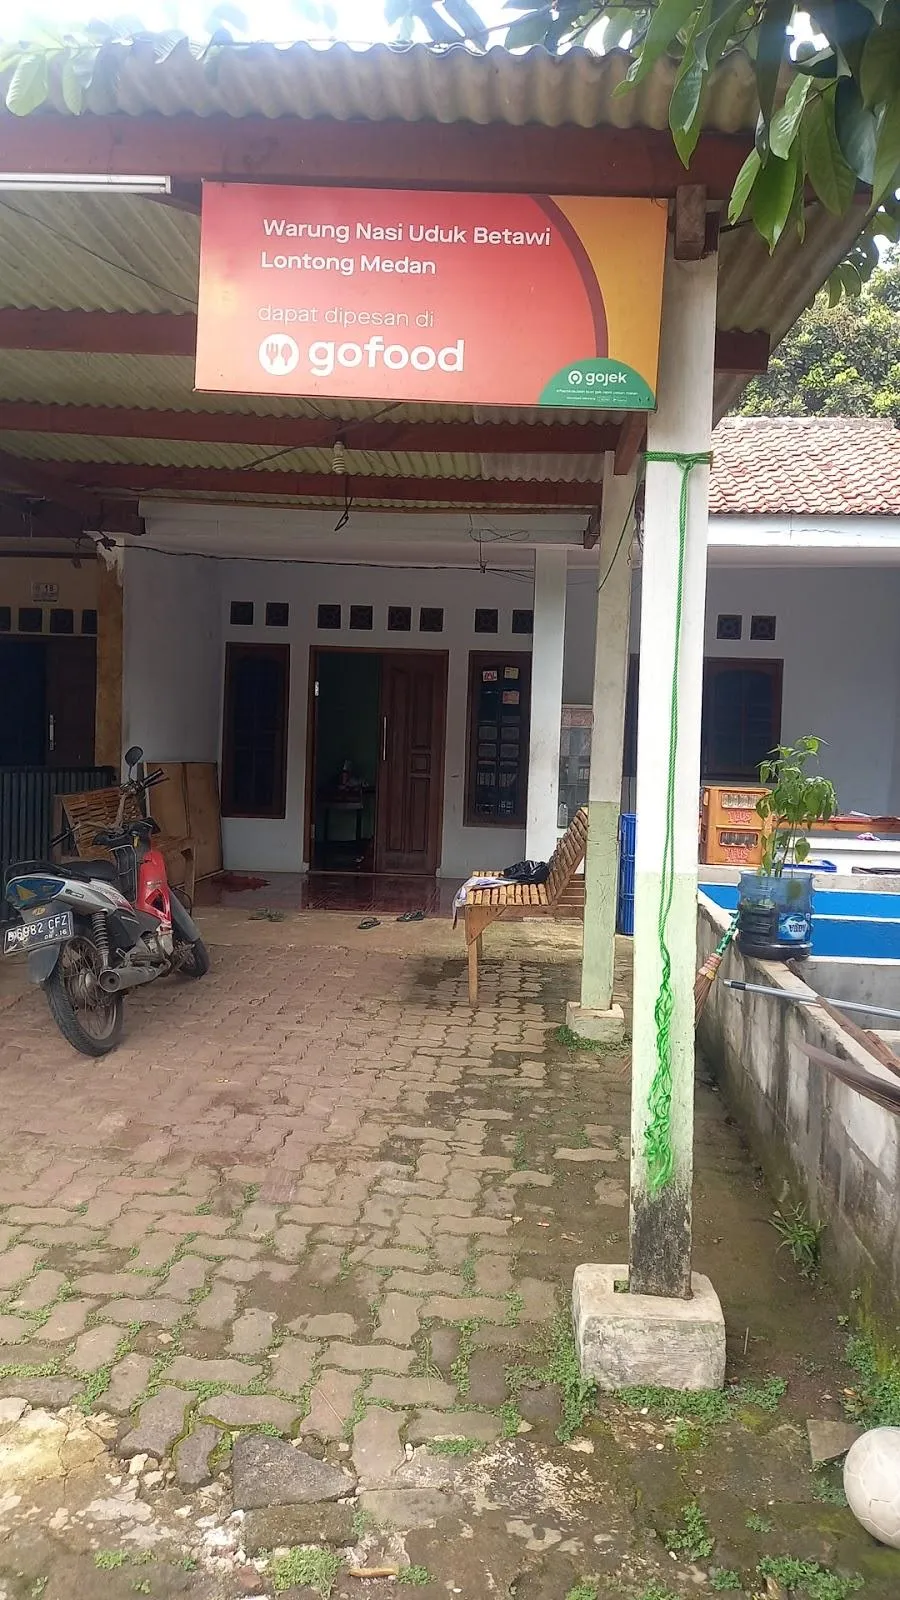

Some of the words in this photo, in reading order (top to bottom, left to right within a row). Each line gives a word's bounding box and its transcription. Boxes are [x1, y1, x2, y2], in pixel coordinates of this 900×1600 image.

[263, 218, 351, 244] Warung
[356, 222, 404, 241] Nasi
[409, 224, 468, 243] Uduk
[473, 227, 552, 246] Betawi
[261, 250, 354, 276] Lontong
[360, 253, 437, 275] Medan
[257, 304, 319, 325] dapat
[324, 307, 409, 329] dipesan
[415, 311, 435, 328] di
[307, 335, 465, 377] gofood
[585, 371, 628, 386] gojek
[48, 914, 68, 930] CFZ
